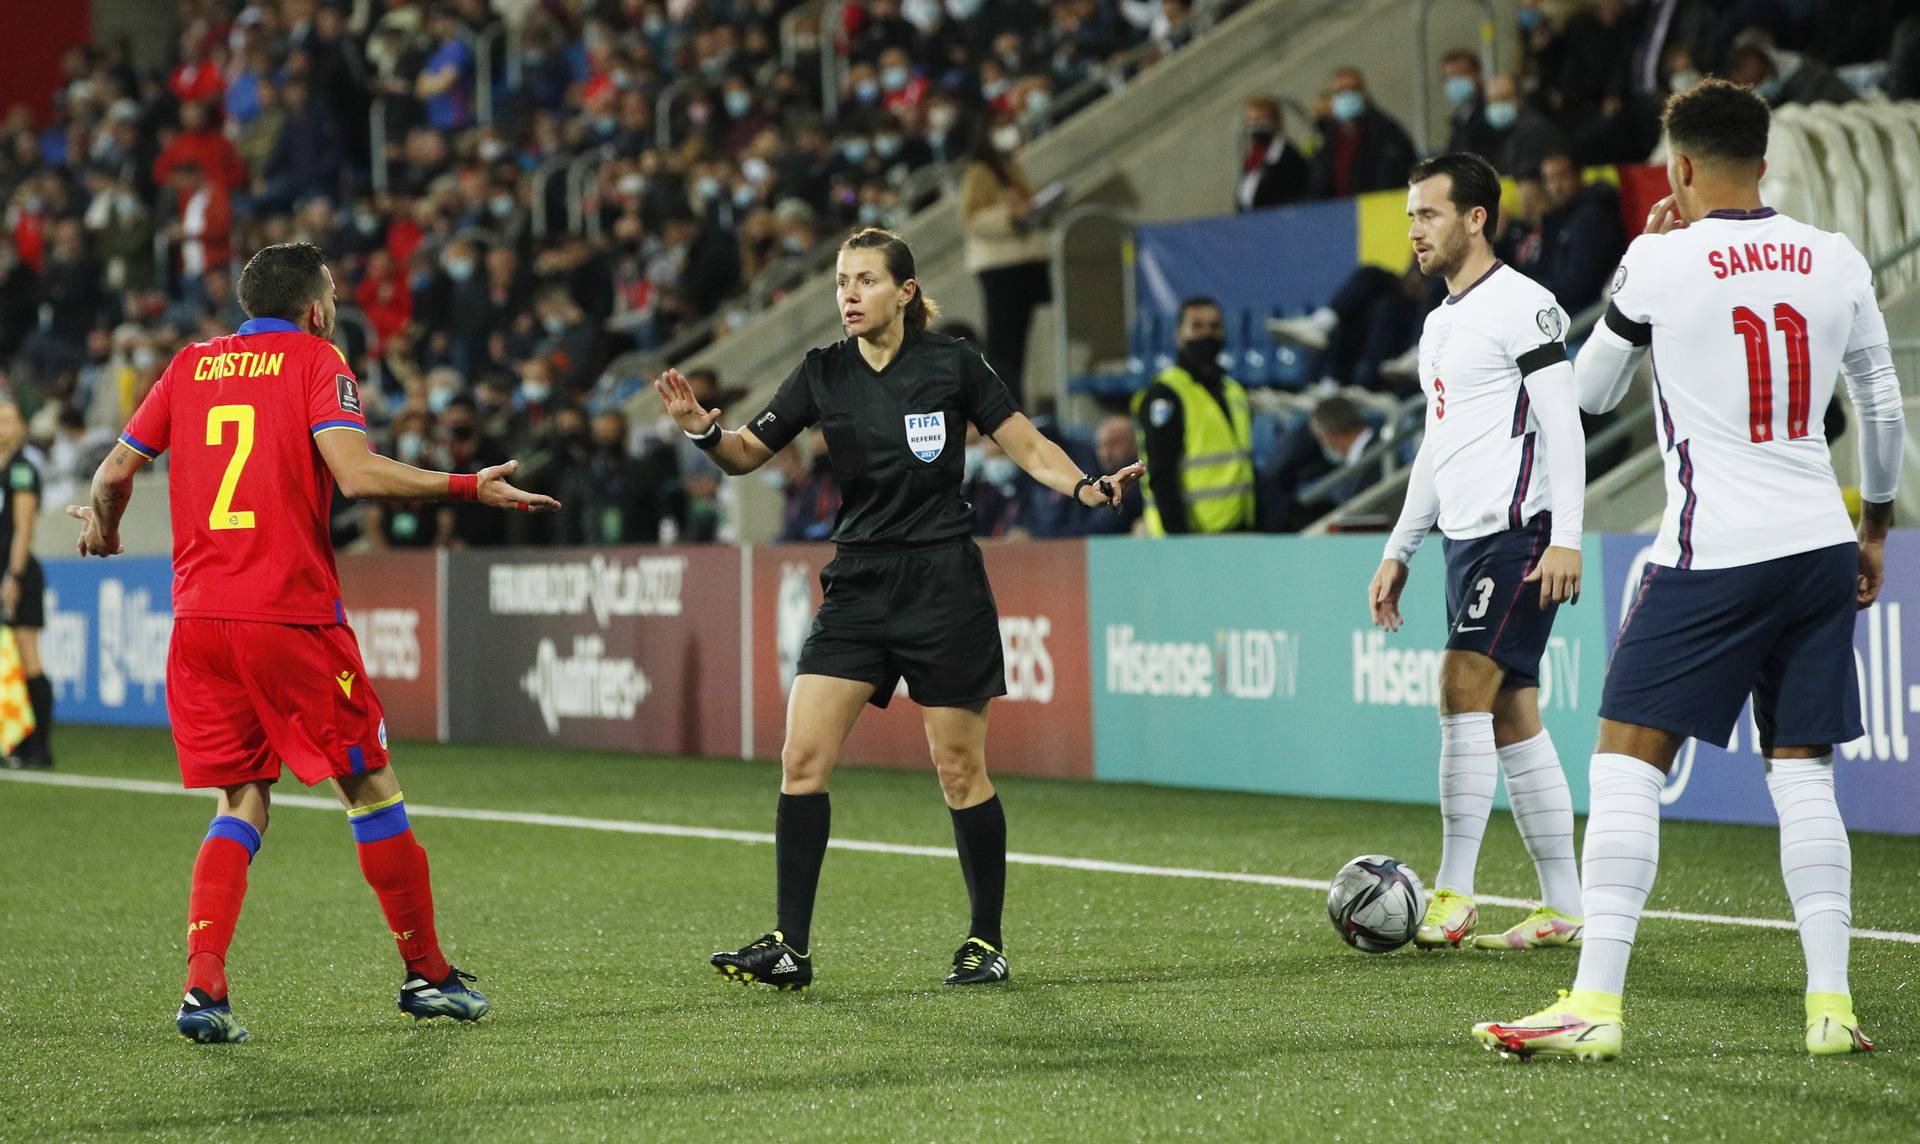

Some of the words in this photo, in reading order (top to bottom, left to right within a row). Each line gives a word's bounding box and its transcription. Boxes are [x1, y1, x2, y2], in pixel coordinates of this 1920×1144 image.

[1708, 242, 1812, 280] SANCHO
[194, 351, 285, 382] CRISTIAN
[1732, 302, 1811, 443] 11
[1433, 377, 1445, 420] 3
[908, 415, 940, 428] FIFA
[911, 434, 943, 443] REFEREE
[206, 404, 256, 531] 2
[1467, 577, 1495, 620] 3
[1106, 623, 1214, 698] Hisense
[1352, 628, 1446, 706] Hisen
